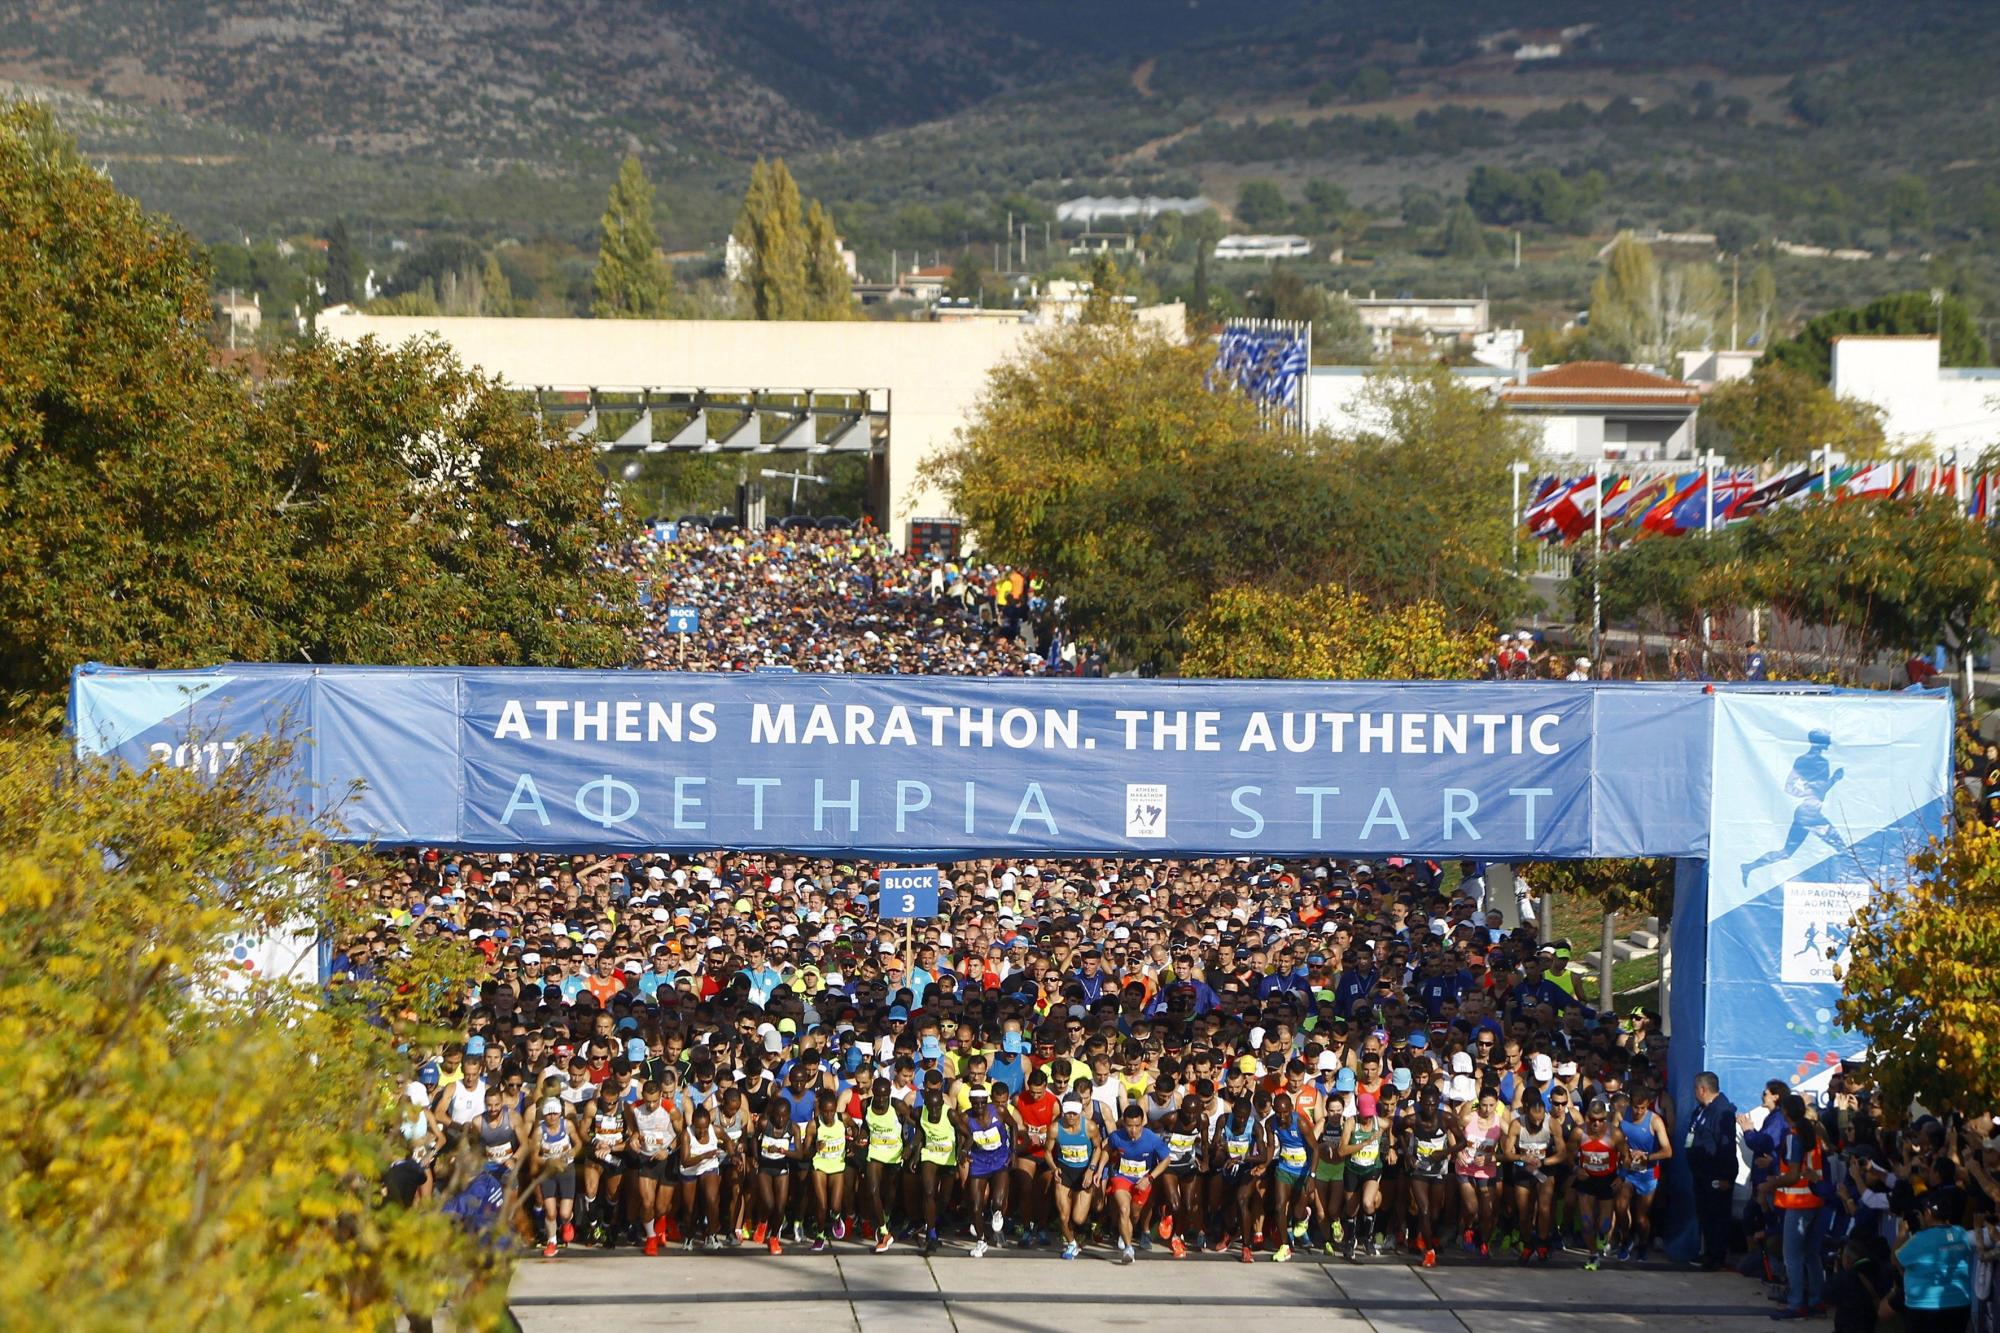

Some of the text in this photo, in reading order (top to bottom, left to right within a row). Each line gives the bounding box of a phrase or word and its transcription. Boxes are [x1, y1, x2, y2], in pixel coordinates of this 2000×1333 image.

[670, 609, 695, 618] BLOCK
[678, 618, 688, 630] 6
[494, 699, 1561, 755] ATHENS MARATHON. THE AUTHENTIC
[499, 772, 1061, 836] ΑΦΕΤΗΡΙΑ
[1229, 785, 1553, 840] START
[885, 876, 933, 889] BLOCK
[902, 894, 915, 913] 3
